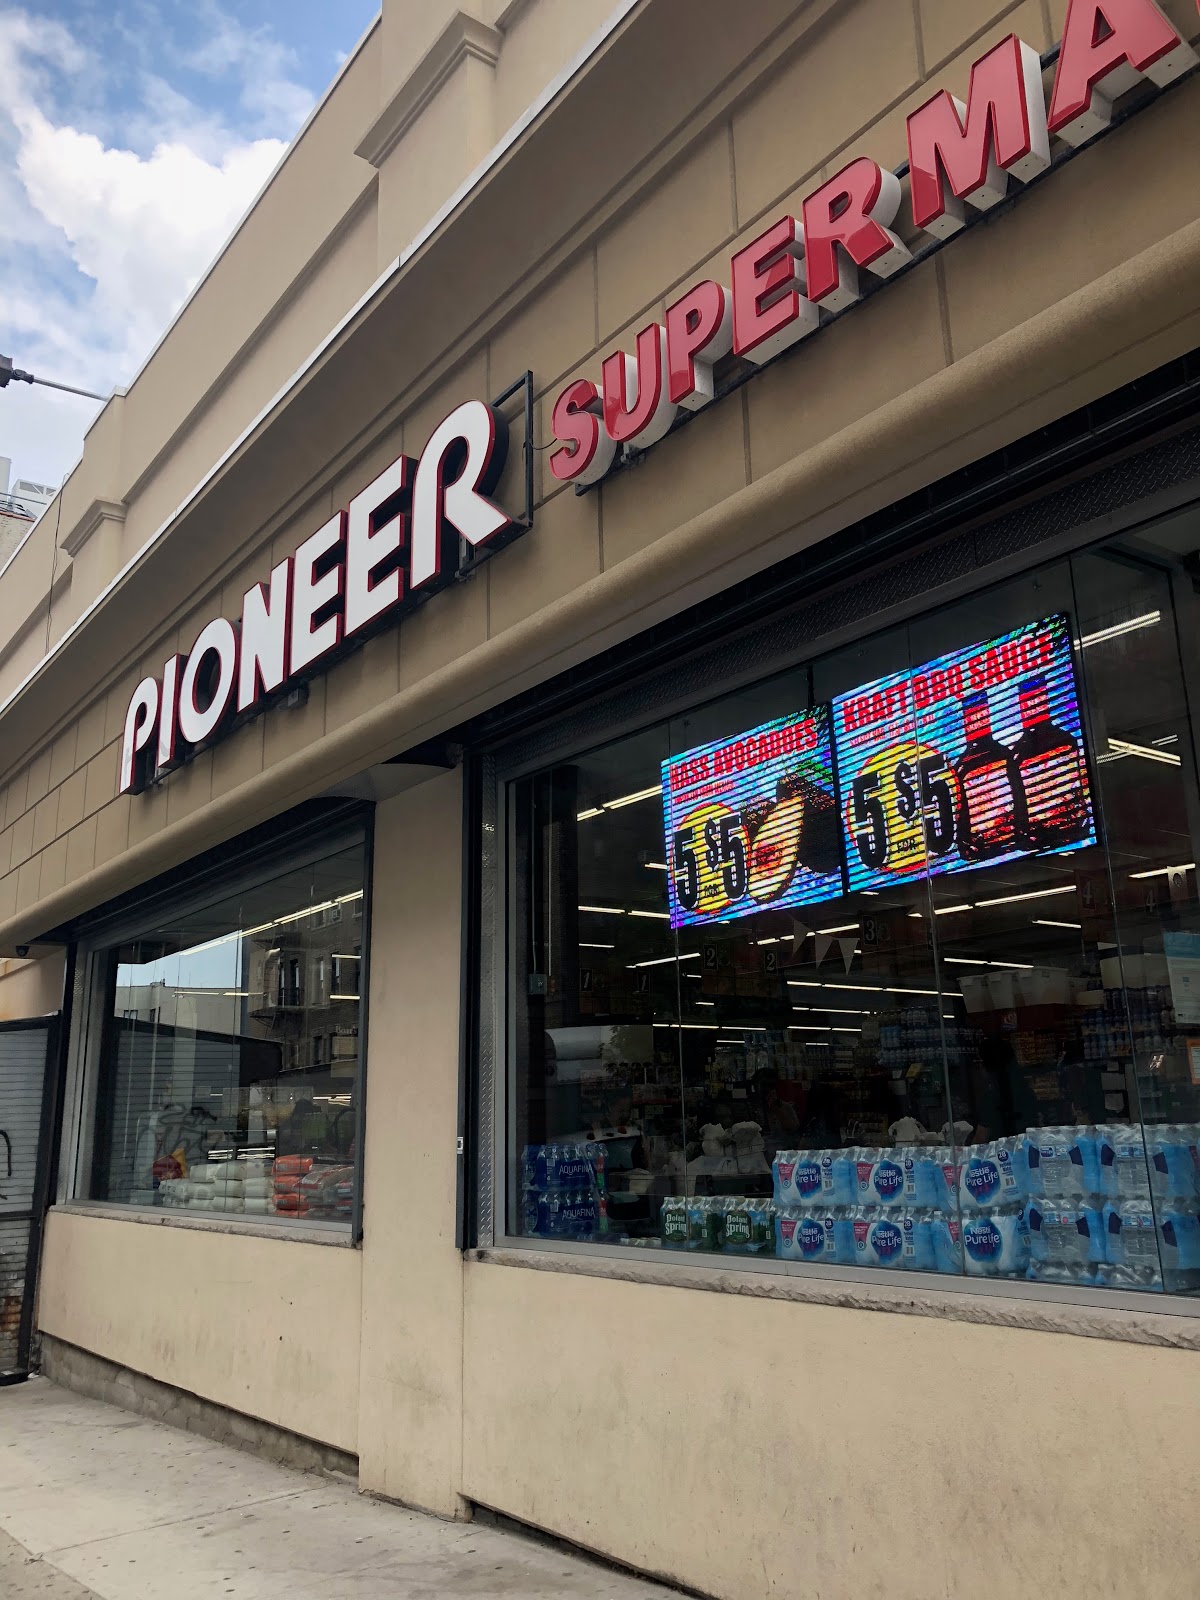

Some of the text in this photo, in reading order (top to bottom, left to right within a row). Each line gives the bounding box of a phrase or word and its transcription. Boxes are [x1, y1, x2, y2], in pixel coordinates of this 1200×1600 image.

[118, 0, 1200, 795] PIONEER SUPERMA
[842, 679, 909, 733] KRAFT
[967, 632, 1054, 691] SAUCE
[865, 919, 876, 941] 3
[706, 947, 716, 967] 2
[766, 952, 776, 971] 2
[964, 1234, 988, 1246] Pure
[969, 1225, 992, 1235] Nestl
